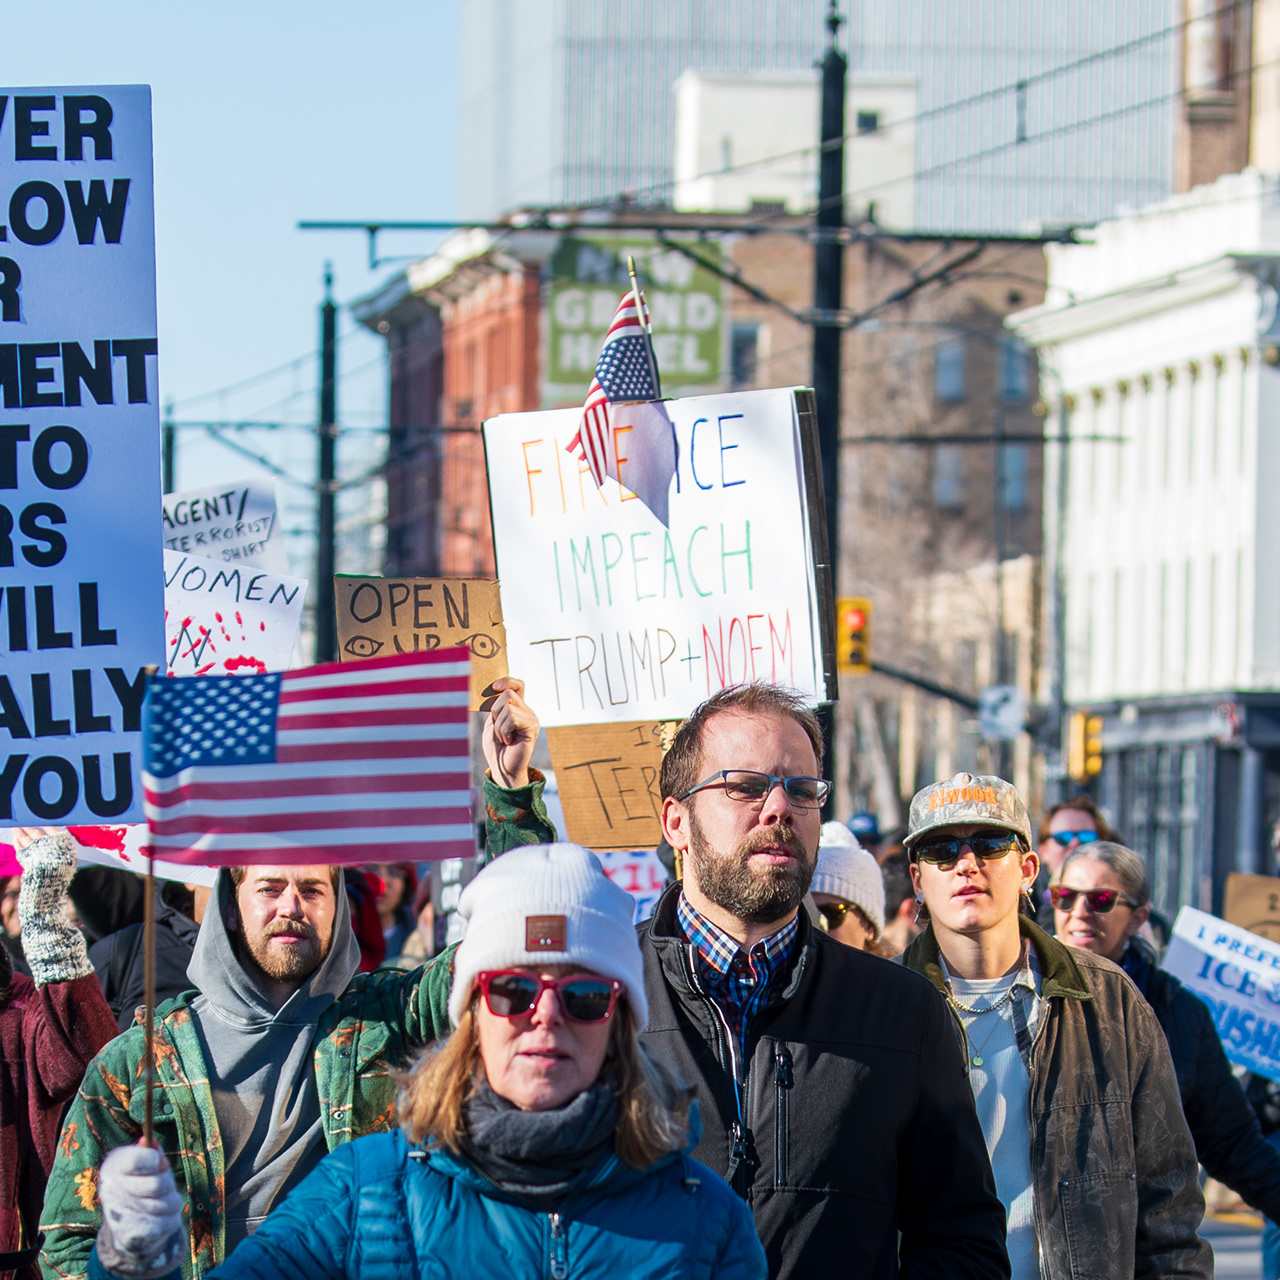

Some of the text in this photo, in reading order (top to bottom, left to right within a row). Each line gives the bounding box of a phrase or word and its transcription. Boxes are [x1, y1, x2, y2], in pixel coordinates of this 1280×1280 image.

[555, 289, 717, 333] GRND
[560, 332, 710, 375] HEL
[669, 413, 746, 494] ICE
[553, 520, 753, 612] IMPEACH
[350, 582, 469, 629] OPEN
[1197, 953, 1261, 998] ICE
